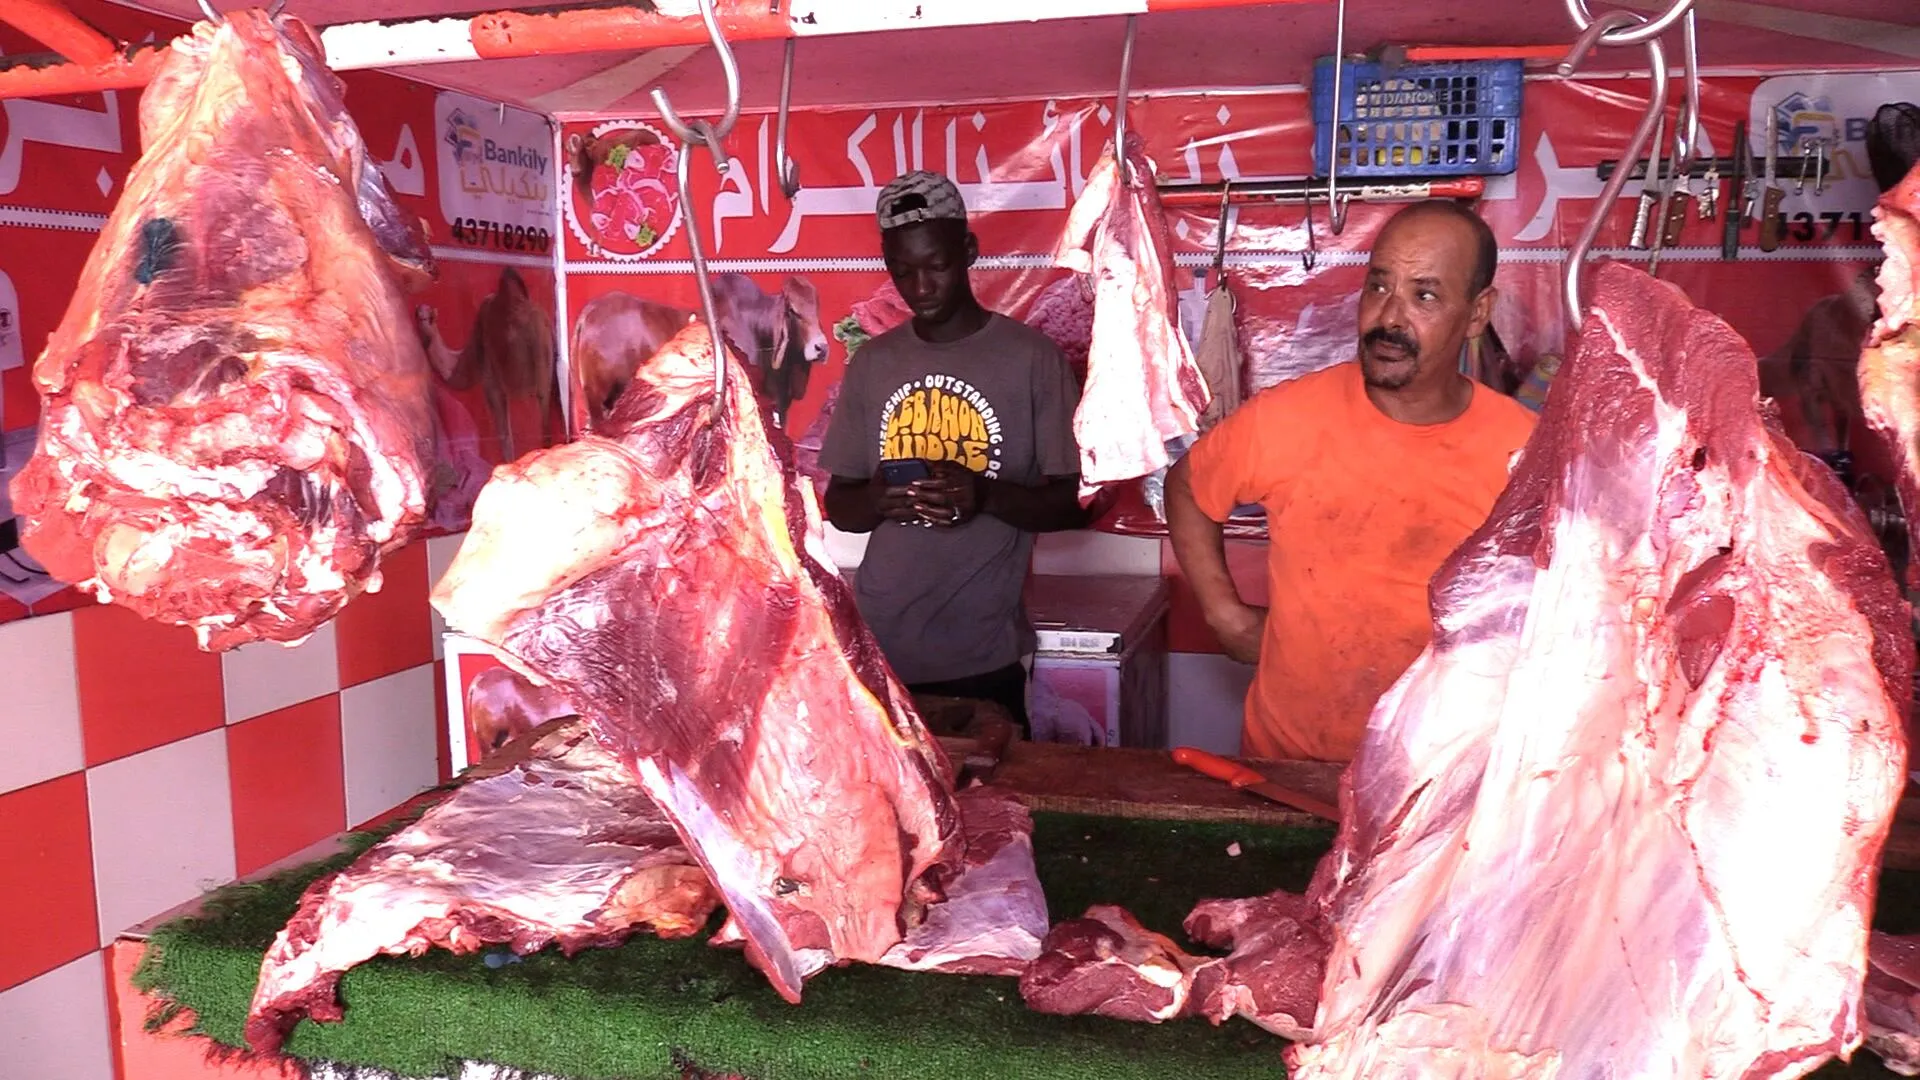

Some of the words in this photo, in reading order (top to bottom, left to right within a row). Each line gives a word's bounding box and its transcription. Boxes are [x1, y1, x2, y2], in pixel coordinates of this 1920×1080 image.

[1385, 90, 1449, 105] DANONE
[483, 139, 548, 176] Bankily
[713, 108, 924, 254] الكرام
[453, 217, 550, 250] 43718290
[880, 383, 912, 461] TIZENSHIP
[925, 374, 1003, 444] OUTSTANDING
[887, 388, 988, 441] LEBANON
[884, 430, 989, 472] MIDDLE
